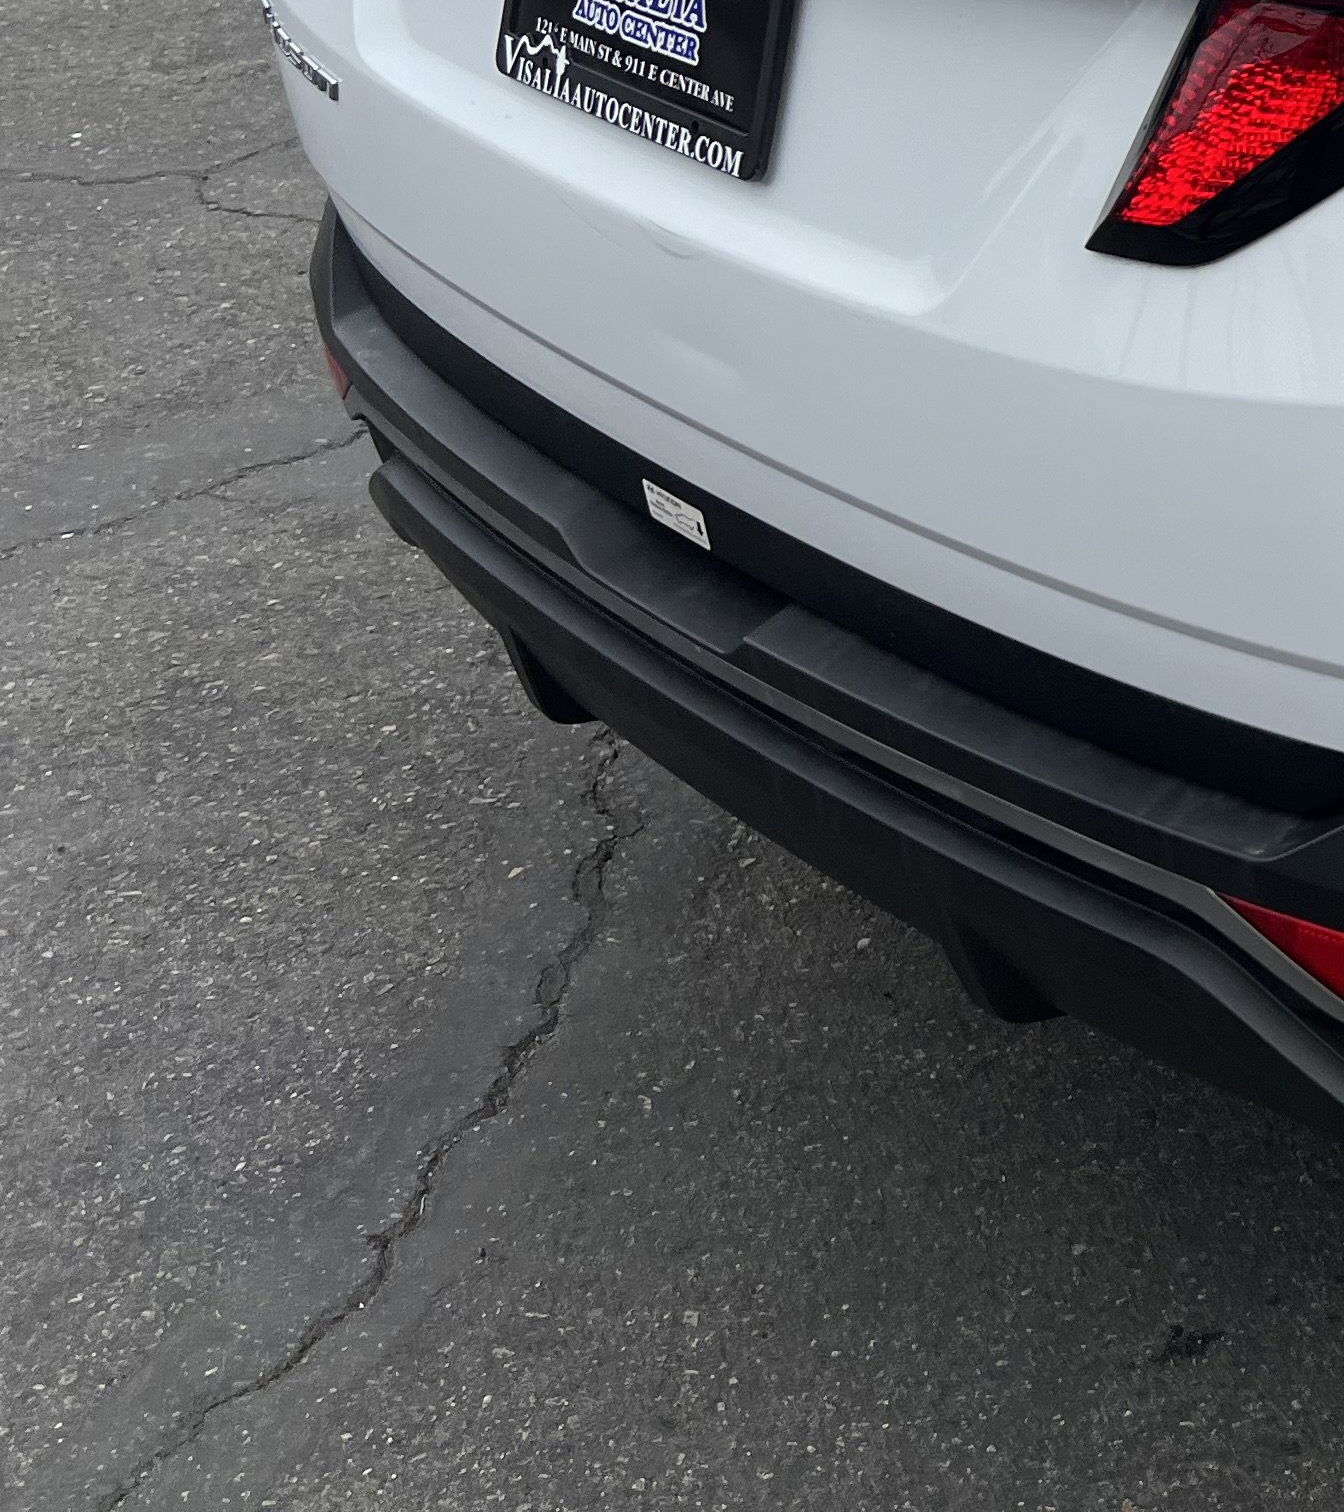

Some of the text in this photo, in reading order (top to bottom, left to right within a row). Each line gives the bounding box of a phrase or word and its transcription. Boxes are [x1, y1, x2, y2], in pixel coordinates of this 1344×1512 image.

[560, 26, 569, 44] E
[569, 31, 598, 57] MAIN
[598, 41, 613, 63] ST
[612, 49, 622, 68] &
[624, 55, 646, 77] 911
[648, 63, 659, 82] E
[660, 68, 710, 102] CENTER
[711, 88, 735, 113] AVE
[620, 9, 700, 67] CENTER
